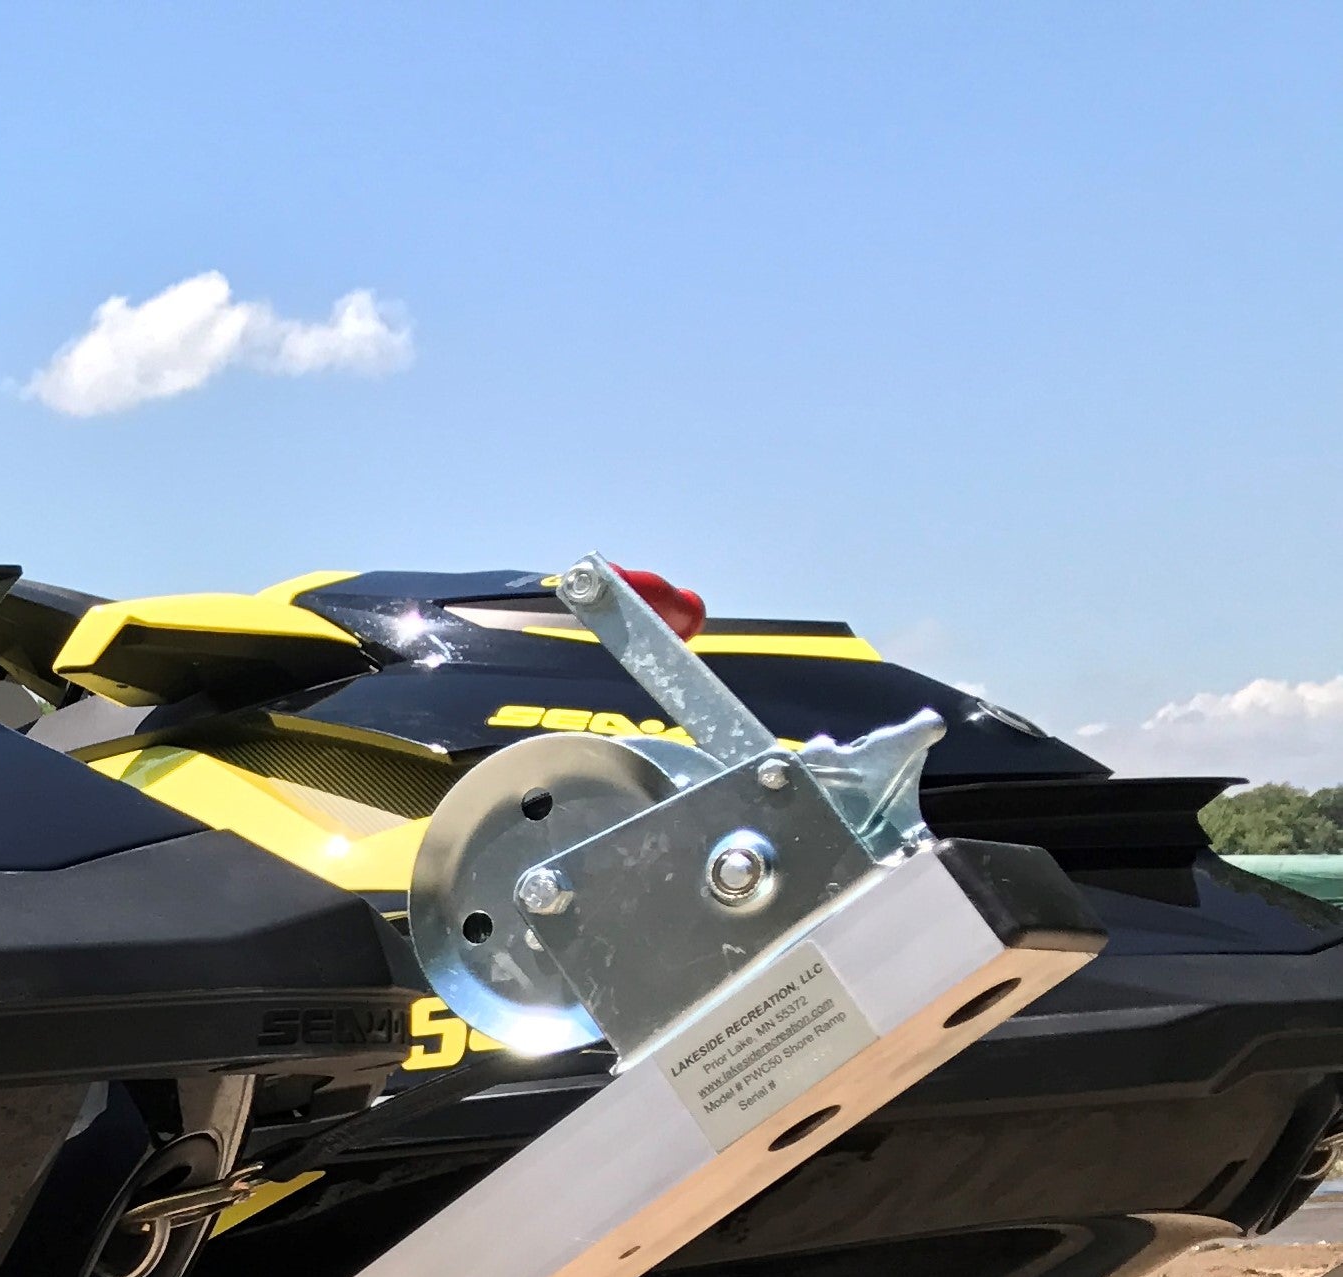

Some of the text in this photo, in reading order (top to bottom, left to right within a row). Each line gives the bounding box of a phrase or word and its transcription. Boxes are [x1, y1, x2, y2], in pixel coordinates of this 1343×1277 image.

[670, 962, 824, 1078] LAKESIDE RECREATION, LLC
[697, 998, 835, 1100] www.lakesiderecreation.com
[702, 995, 809, 1075] Prior Lake, MN 55372
[703, 1087, 734, 1114] Model
[743, 1054, 783, 1086] PWC50
[784, 1033, 815, 1059] Shore
[813, 1011, 847, 1037] Ramp
[738, 1087, 769, 1111] Serial
